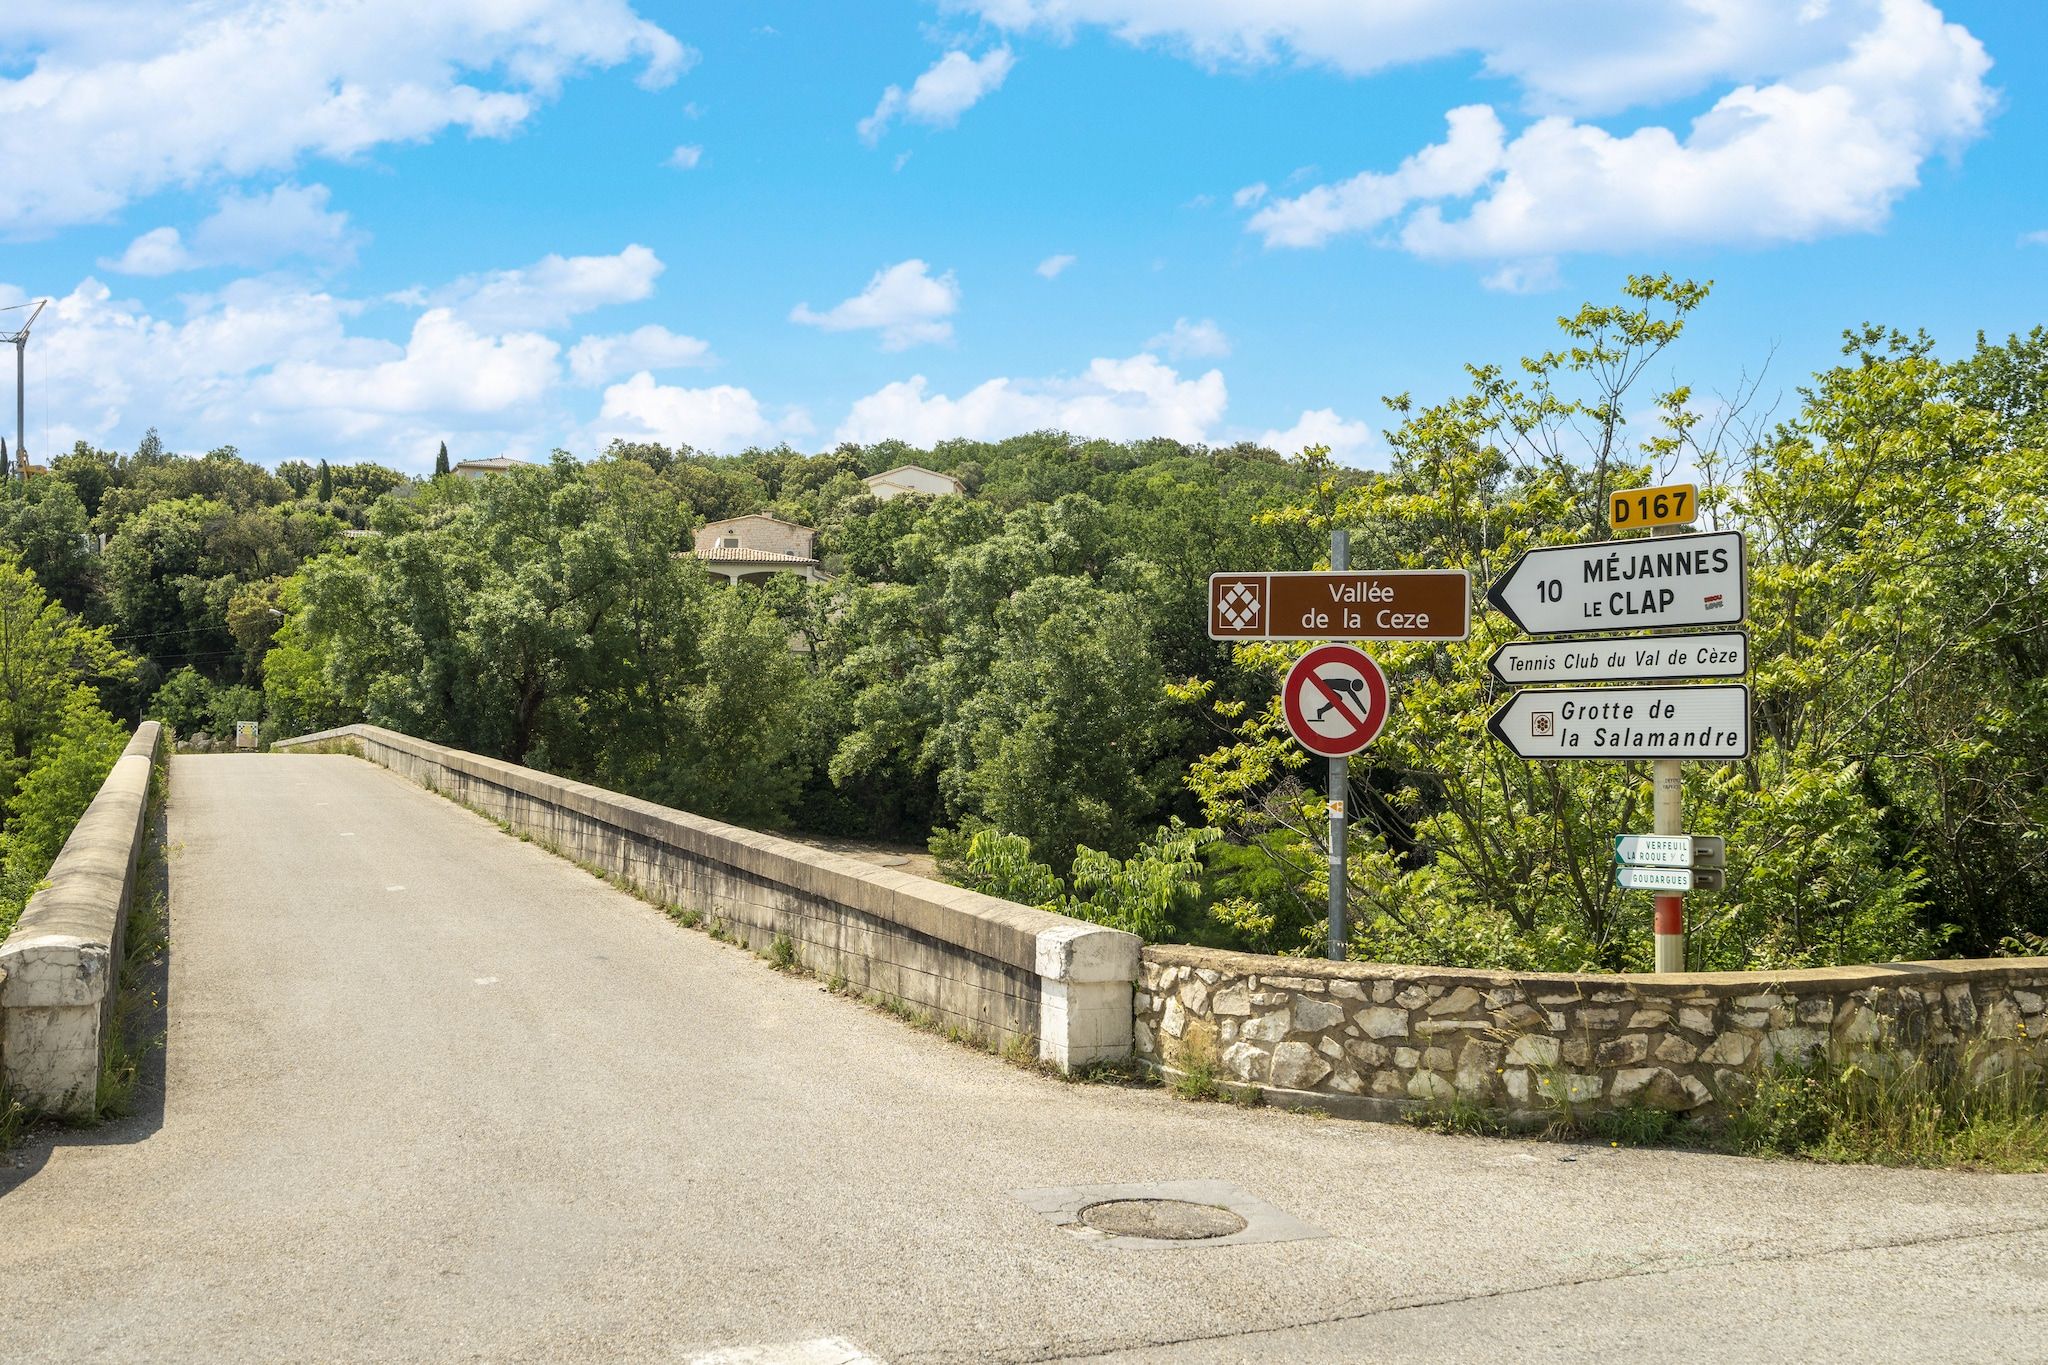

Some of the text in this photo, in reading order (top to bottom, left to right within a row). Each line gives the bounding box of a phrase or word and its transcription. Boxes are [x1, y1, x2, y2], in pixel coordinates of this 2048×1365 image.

[1615, 492, 1687, 522] D 167
[1584, 548, 1728, 583] MÉJANNES
[1328, 581, 1395, 603] Vallée
[1537, 579, 1563, 603] 10
[1584, 589, 1675, 618] LE CLAP
[1301, 608, 1430, 629] de la Ceze
[1509, 647, 1738, 671] Tennis Club du Val de Cèze
[1561, 699, 1675, 720] Grotte de
[1560, 726, 1738, 747] la Salamandre
[1627, 851, 1636, 860] LA
[1639, 852, 1667, 862] ROQUE
[1646, 841, 1687, 851] VERFEUIL
[1633, 874, 1687, 885] GOUDARGUES
